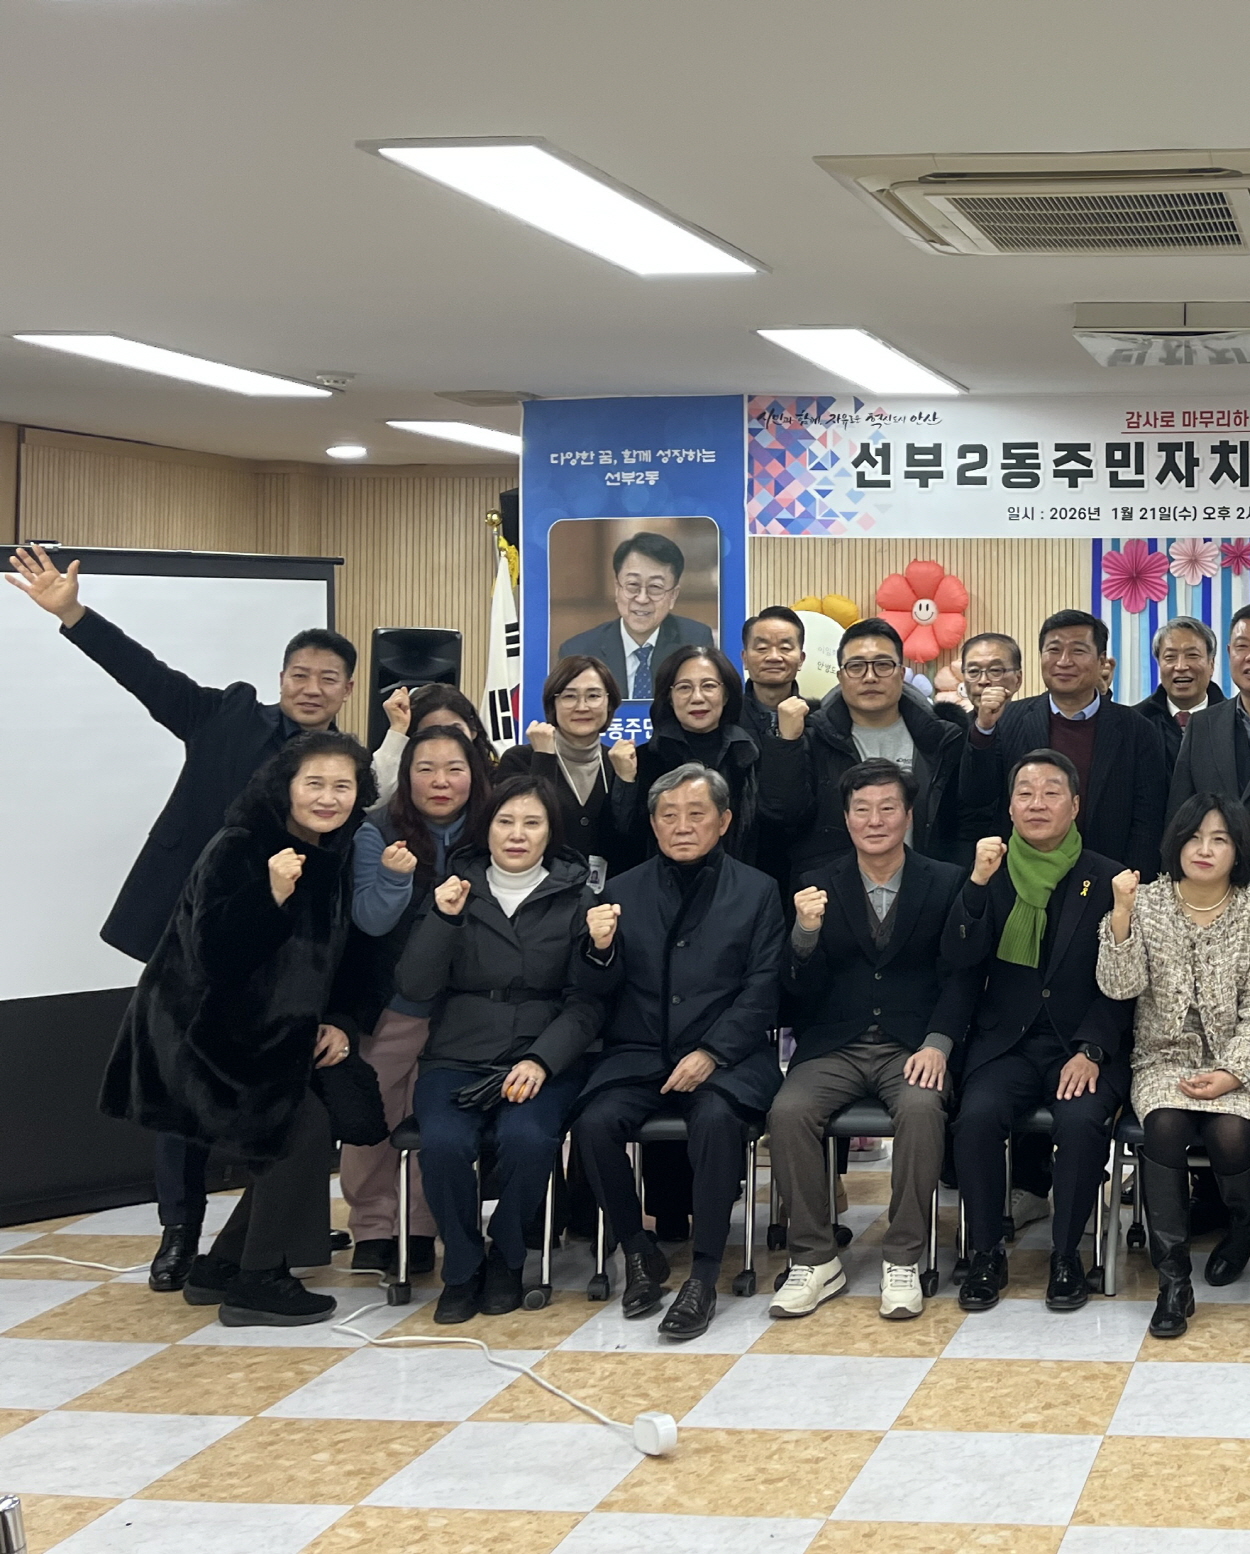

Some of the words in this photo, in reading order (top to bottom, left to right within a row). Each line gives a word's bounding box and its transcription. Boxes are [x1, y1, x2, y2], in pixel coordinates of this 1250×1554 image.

[756, 408, 792, 429] 시민과
[825, 413, 861, 431] 자유로운
[865, 412, 906, 429] 혁신도시
[909, 411, 943, 425] 안산
[1125, 410, 1175, 428] 감사로
[550, 451, 595, 466] 다양한
[599, 450, 618, 465] 꿈,
[621, 449, 652, 464] 함께
[656, 448, 717, 463] 성장하는
[604, 470, 660, 486] 선부2동
[1007, 506, 1035, 521] 일시
[1049, 506, 1101, 520] 2026년
[1112, 506, 1134, 520] 1월
[1139, 505, 1197, 521] 21일(수)
[1203, 506, 1231, 520] 오후
